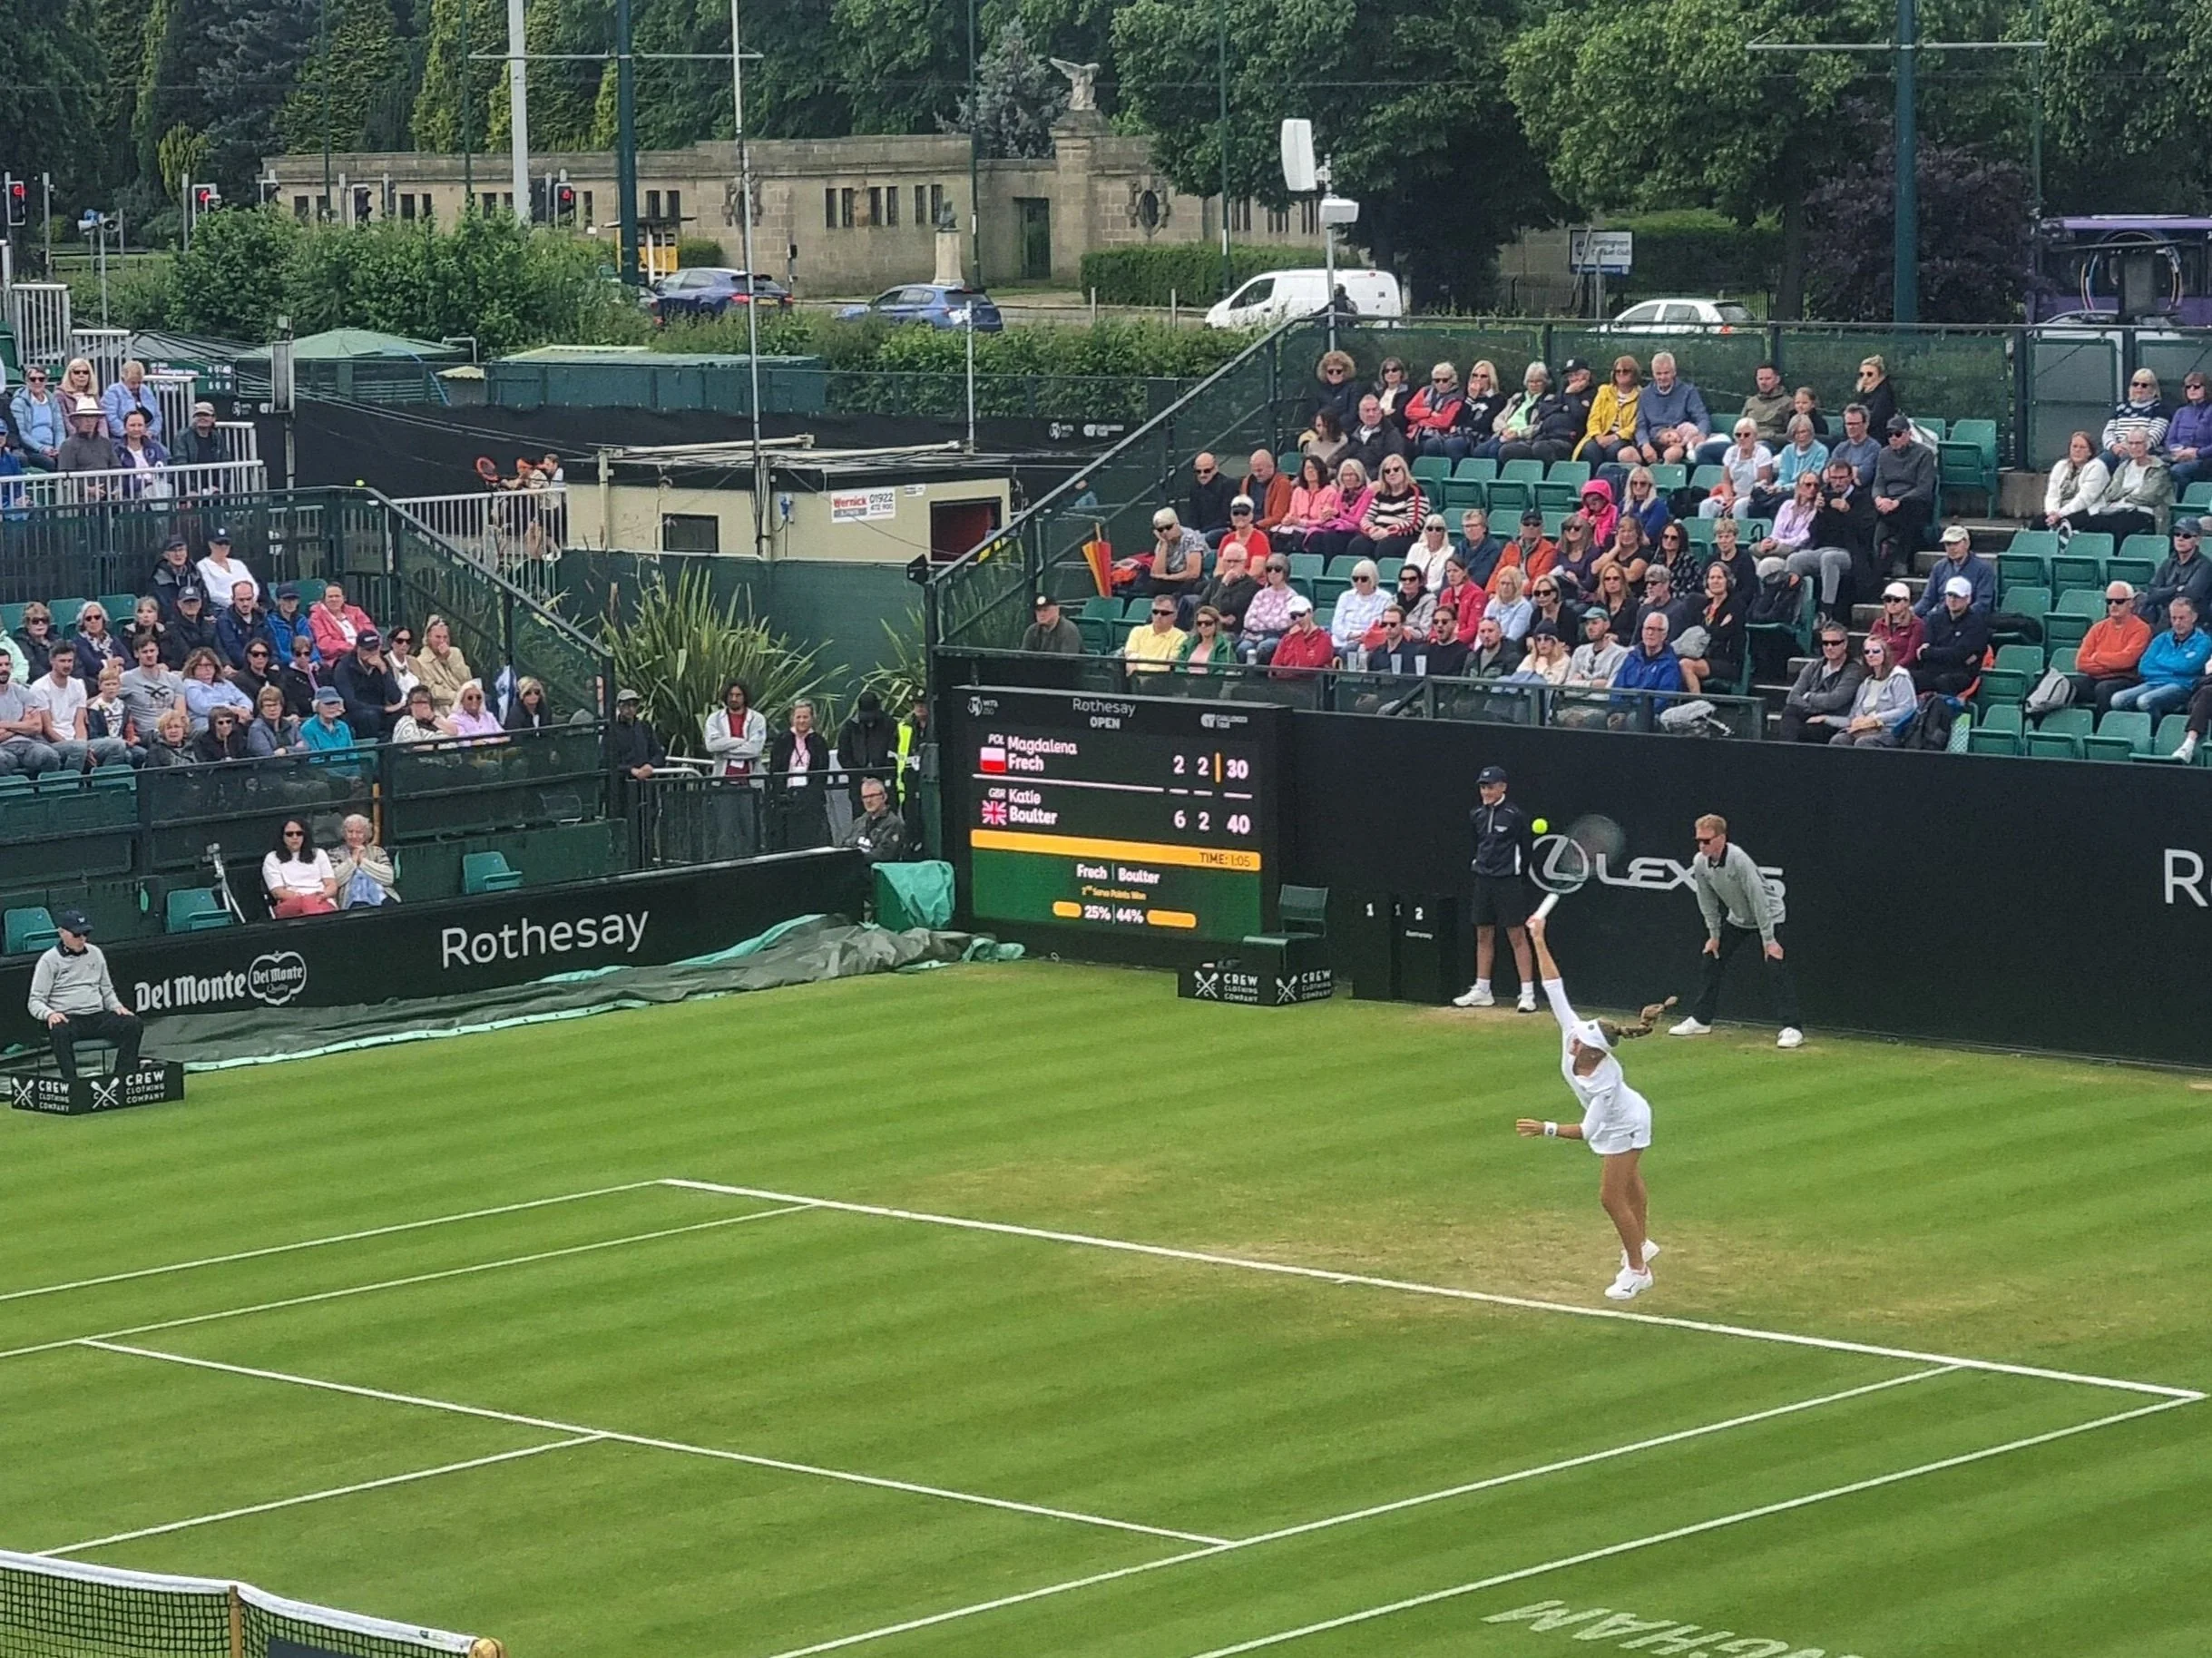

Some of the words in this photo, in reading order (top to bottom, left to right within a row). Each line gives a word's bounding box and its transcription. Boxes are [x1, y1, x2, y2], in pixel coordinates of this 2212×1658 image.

[833, 495, 867, 508] Wernick
[869, 493, 894, 504] 01922
[1072, 698, 1136, 717] Rothesay
[1090, 716, 1121, 730] OPEN
[988, 733, 1004, 745] POL
[1007, 736, 1078, 755] Magdalena
[1008, 753, 1044, 771] Frech
[1173, 755, 1185, 774] 2
[1198, 757, 1209, 776] 2
[1227, 759, 1248, 779] 30
[988, 788, 1006, 799] GBR
[1009, 789, 1042, 805] Katie
[1009, 805, 1058, 825] Boulter
[1174, 809, 1186, 829] 6
[1198, 811, 1209, 830] 2
[1227, 814, 1250, 834] 40
[1199, 851, 1228, 865] TIME:
[1230, 856, 1251, 868] 1:05
[1076, 864, 1108, 880] Frech
[1118, 867, 1160, 884] Boulter
[1595, 853, 1786, 898] LEXS
[2164, 849, 2212, 907] R
[1084, 905, 1111, 921] 25%
[1116, 907, 1144, 924] 44%
[1366, 902, 1374, 917] 1
[1395, 904, 1402, 917] 1
[1415, 907, 1423, 920] 2
[441, 910, 650, 969] Rothesay
[252, 968, 269, 985] Del
[271, 966, 303, 983] Monte
[1223, 973, 1258, 986] CREW
[1301, 969, 1332, 984] CREW
[134, 978, 172, 1013] Del
[173, 969, 247, 1006] Monte
[1224, 986, 1258, 995] CLOTHING
[1301, 982, 1332, 992] CLOTHING
[1301, 989, 1331, 999] COMPANY
[1224, 993, 1258, 1002] COMPANY
[125, 1070, 165, 1086] CREW
[38, 1080, 70, 1094] CREW
[125, 1083, 165, 1095] CLOTHING
[38, 1093, 70, 1104] CLOTHING
[125, 1092, 165, 1104] COMPANY
[38, 1102, 69, 1113] COMPANY
[1481, 1600, 1867, 1658] GHAM
